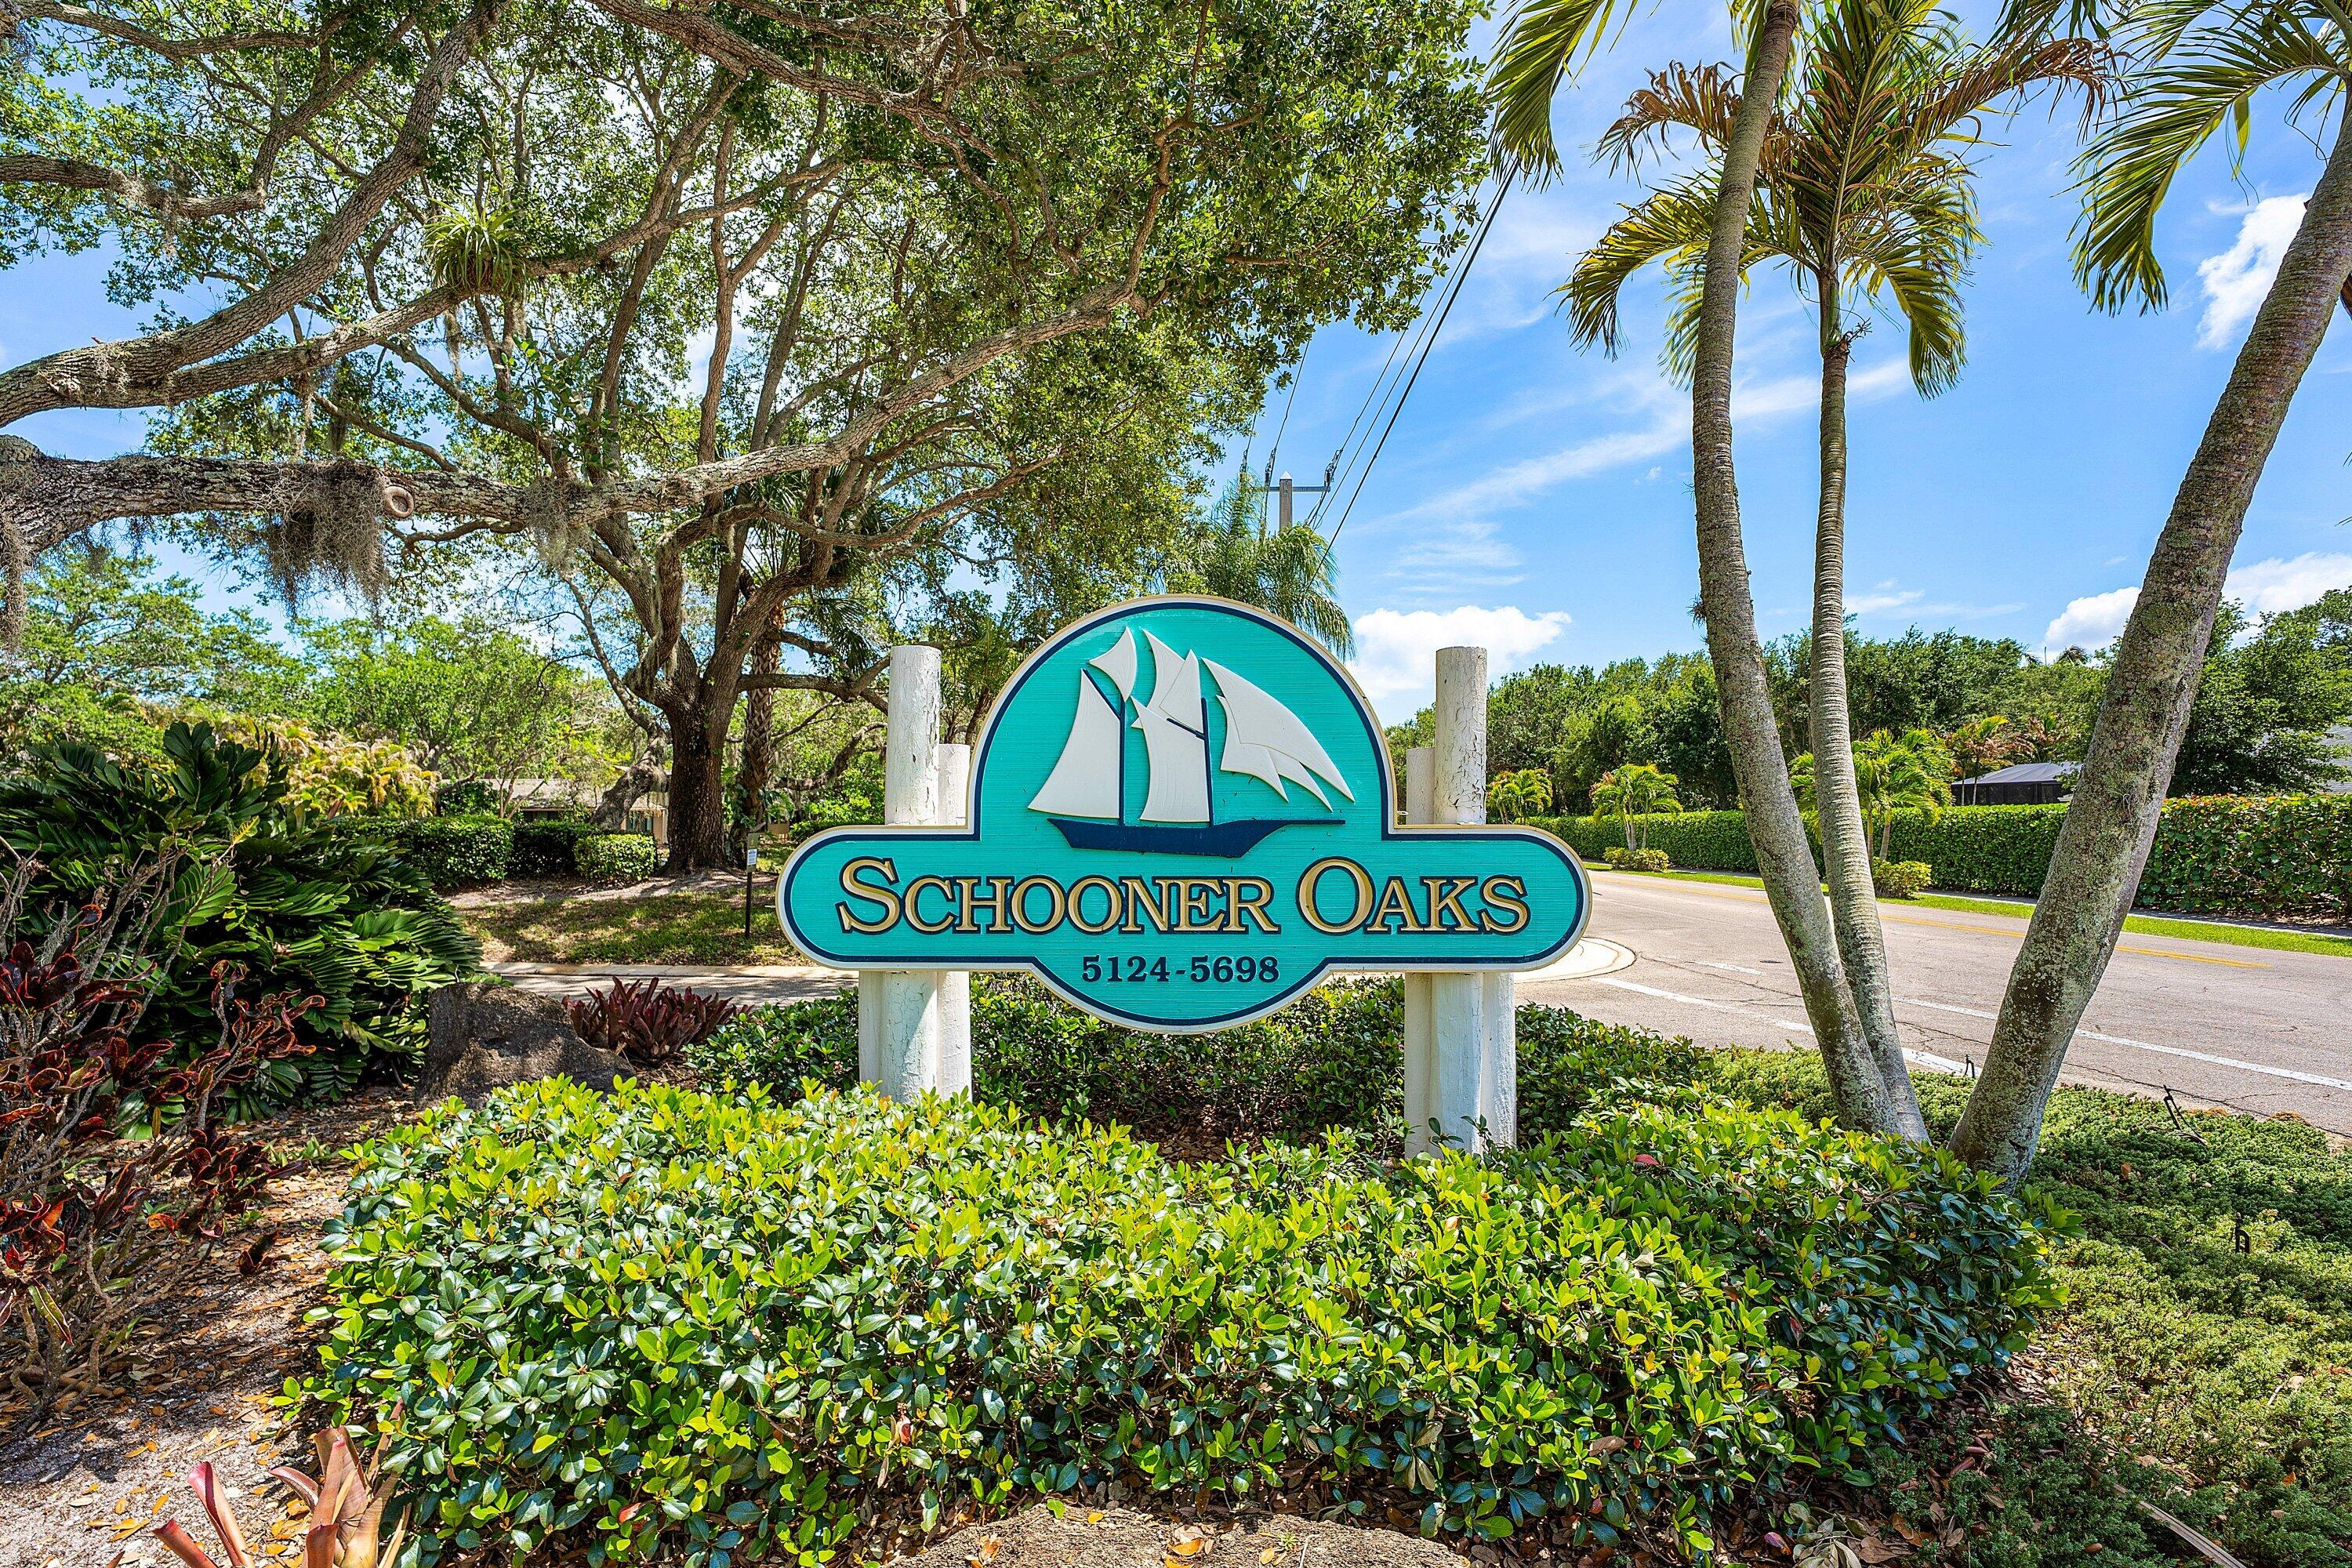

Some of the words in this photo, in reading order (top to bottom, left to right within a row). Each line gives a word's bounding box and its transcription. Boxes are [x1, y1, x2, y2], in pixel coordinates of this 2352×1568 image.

[835, 856, 1281, 935] SCHOONER
[1296, 855, 1532, 935] OAKS
[1082, 955, 1279, 983] 5124-5698
